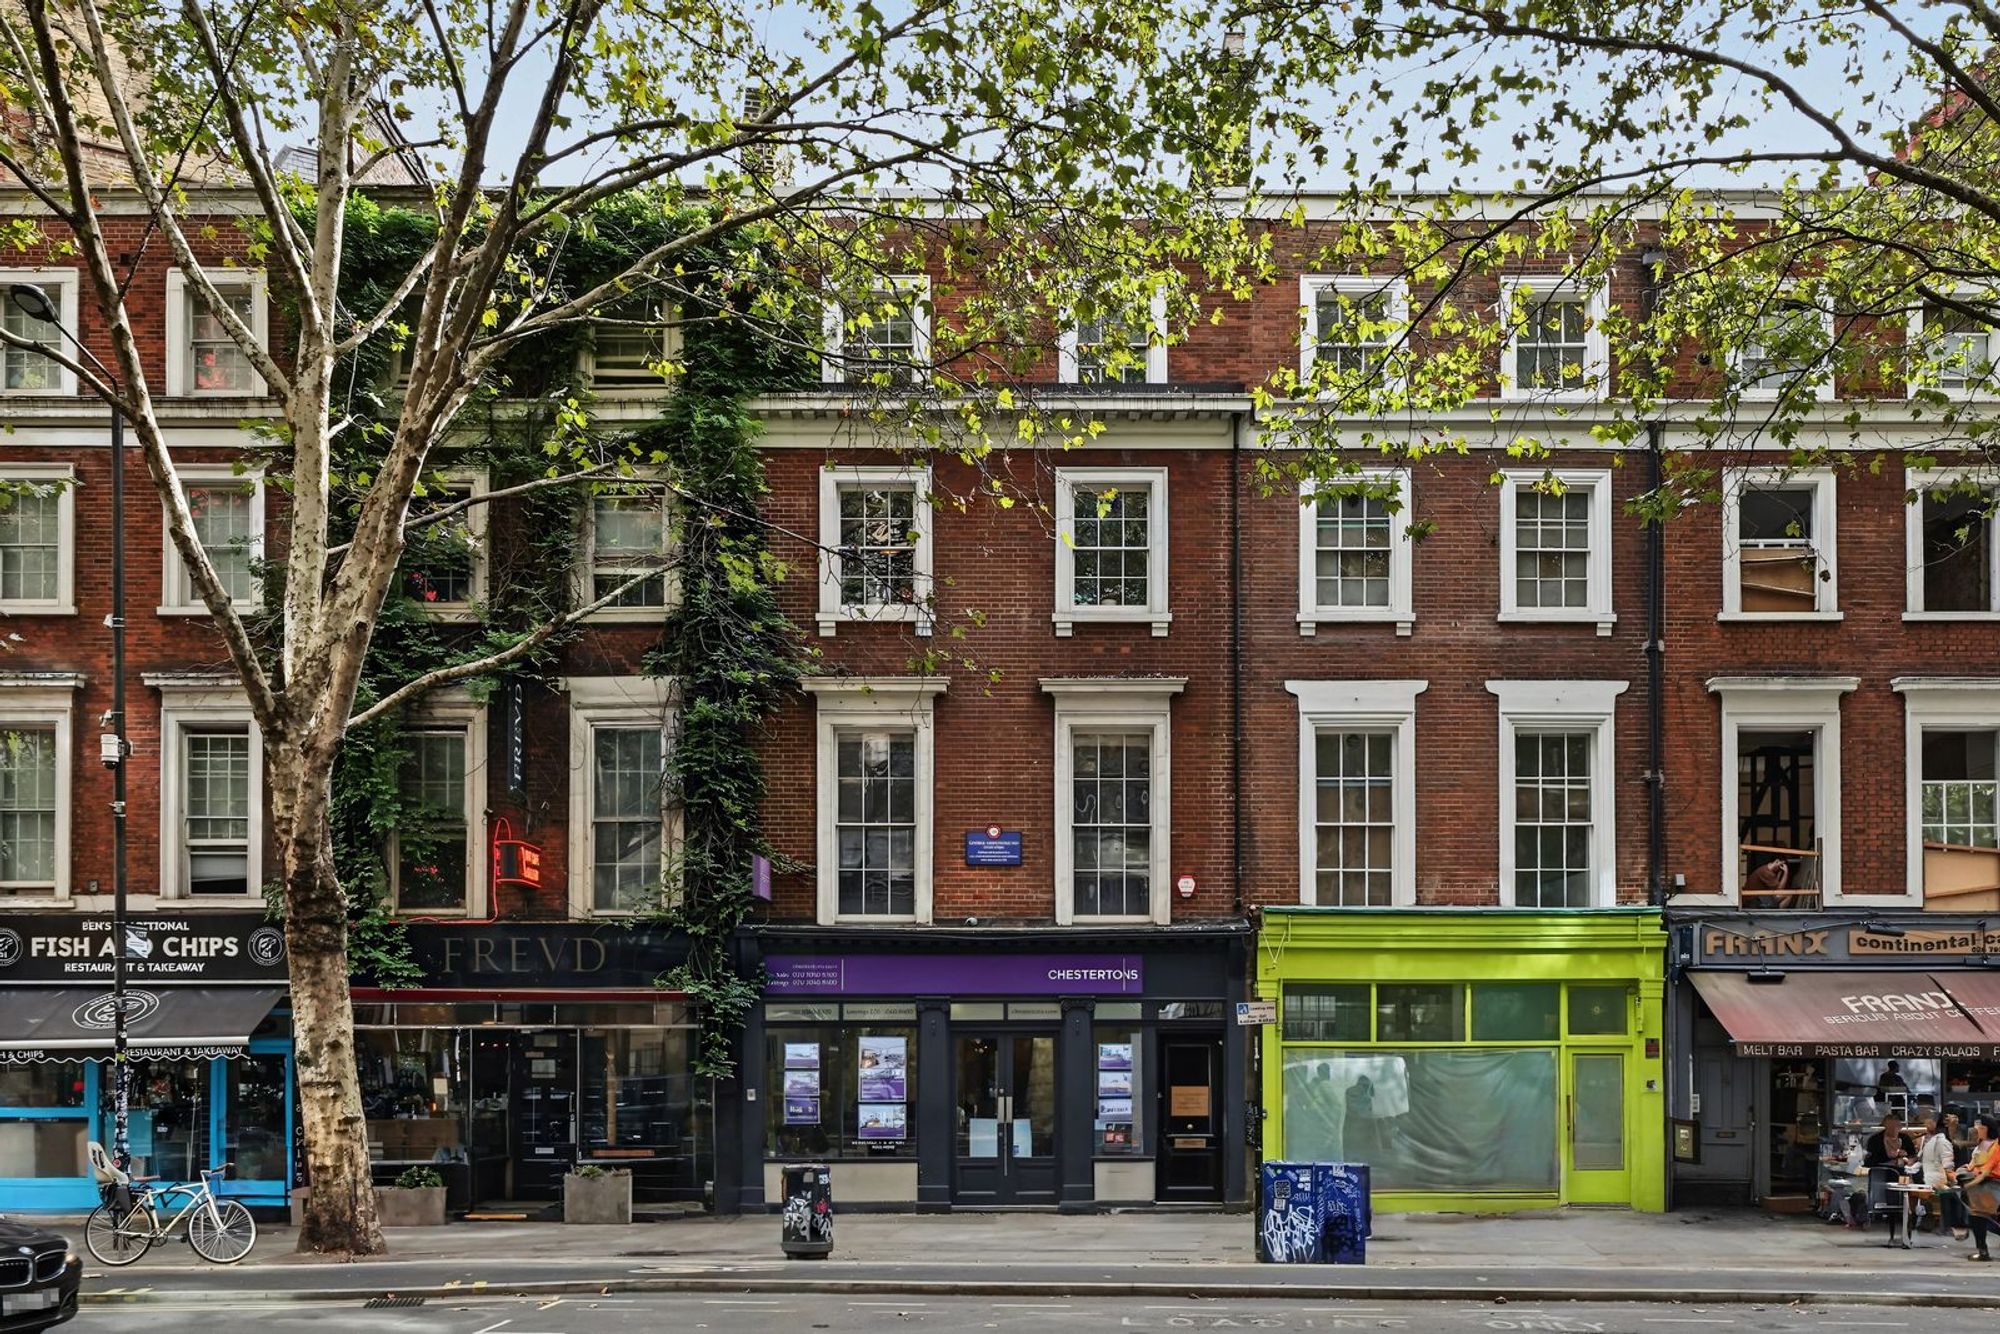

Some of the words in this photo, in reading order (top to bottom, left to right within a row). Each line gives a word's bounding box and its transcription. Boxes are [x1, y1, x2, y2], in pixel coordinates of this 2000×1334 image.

[82, 921, 112, 931] BEN'S
[31, 936, 91, 957] FISH
[162, 936, 239, 957] CHIPS
[1856, 932, 1976, 952] continental
[146, 962, 206, 972] TAKEAWAY
[1047, 969, 1139, 981] CHESTERTONS
[1823, 1012, 1888, 1025] SERIOUS
[1894, 1010, 1942, 1021] ABOUT
[17, 1050, 45, 1059] CHIPS
[183, 1047, 191, 1056] &
[192, 1045, 243, 1056] TAKEAWAY
[1743, 1045, 1775, 1056] MELT
[1777, 1045, 1803, 1056] BAR
[1815, 1045, 1854, 1057] PASTA
[1855, 1045, 1880, 1057] BAR
[1891, 1045, 1932, 1057] CRAZY
[1933, 1046, 1981, 1057] SALADS
